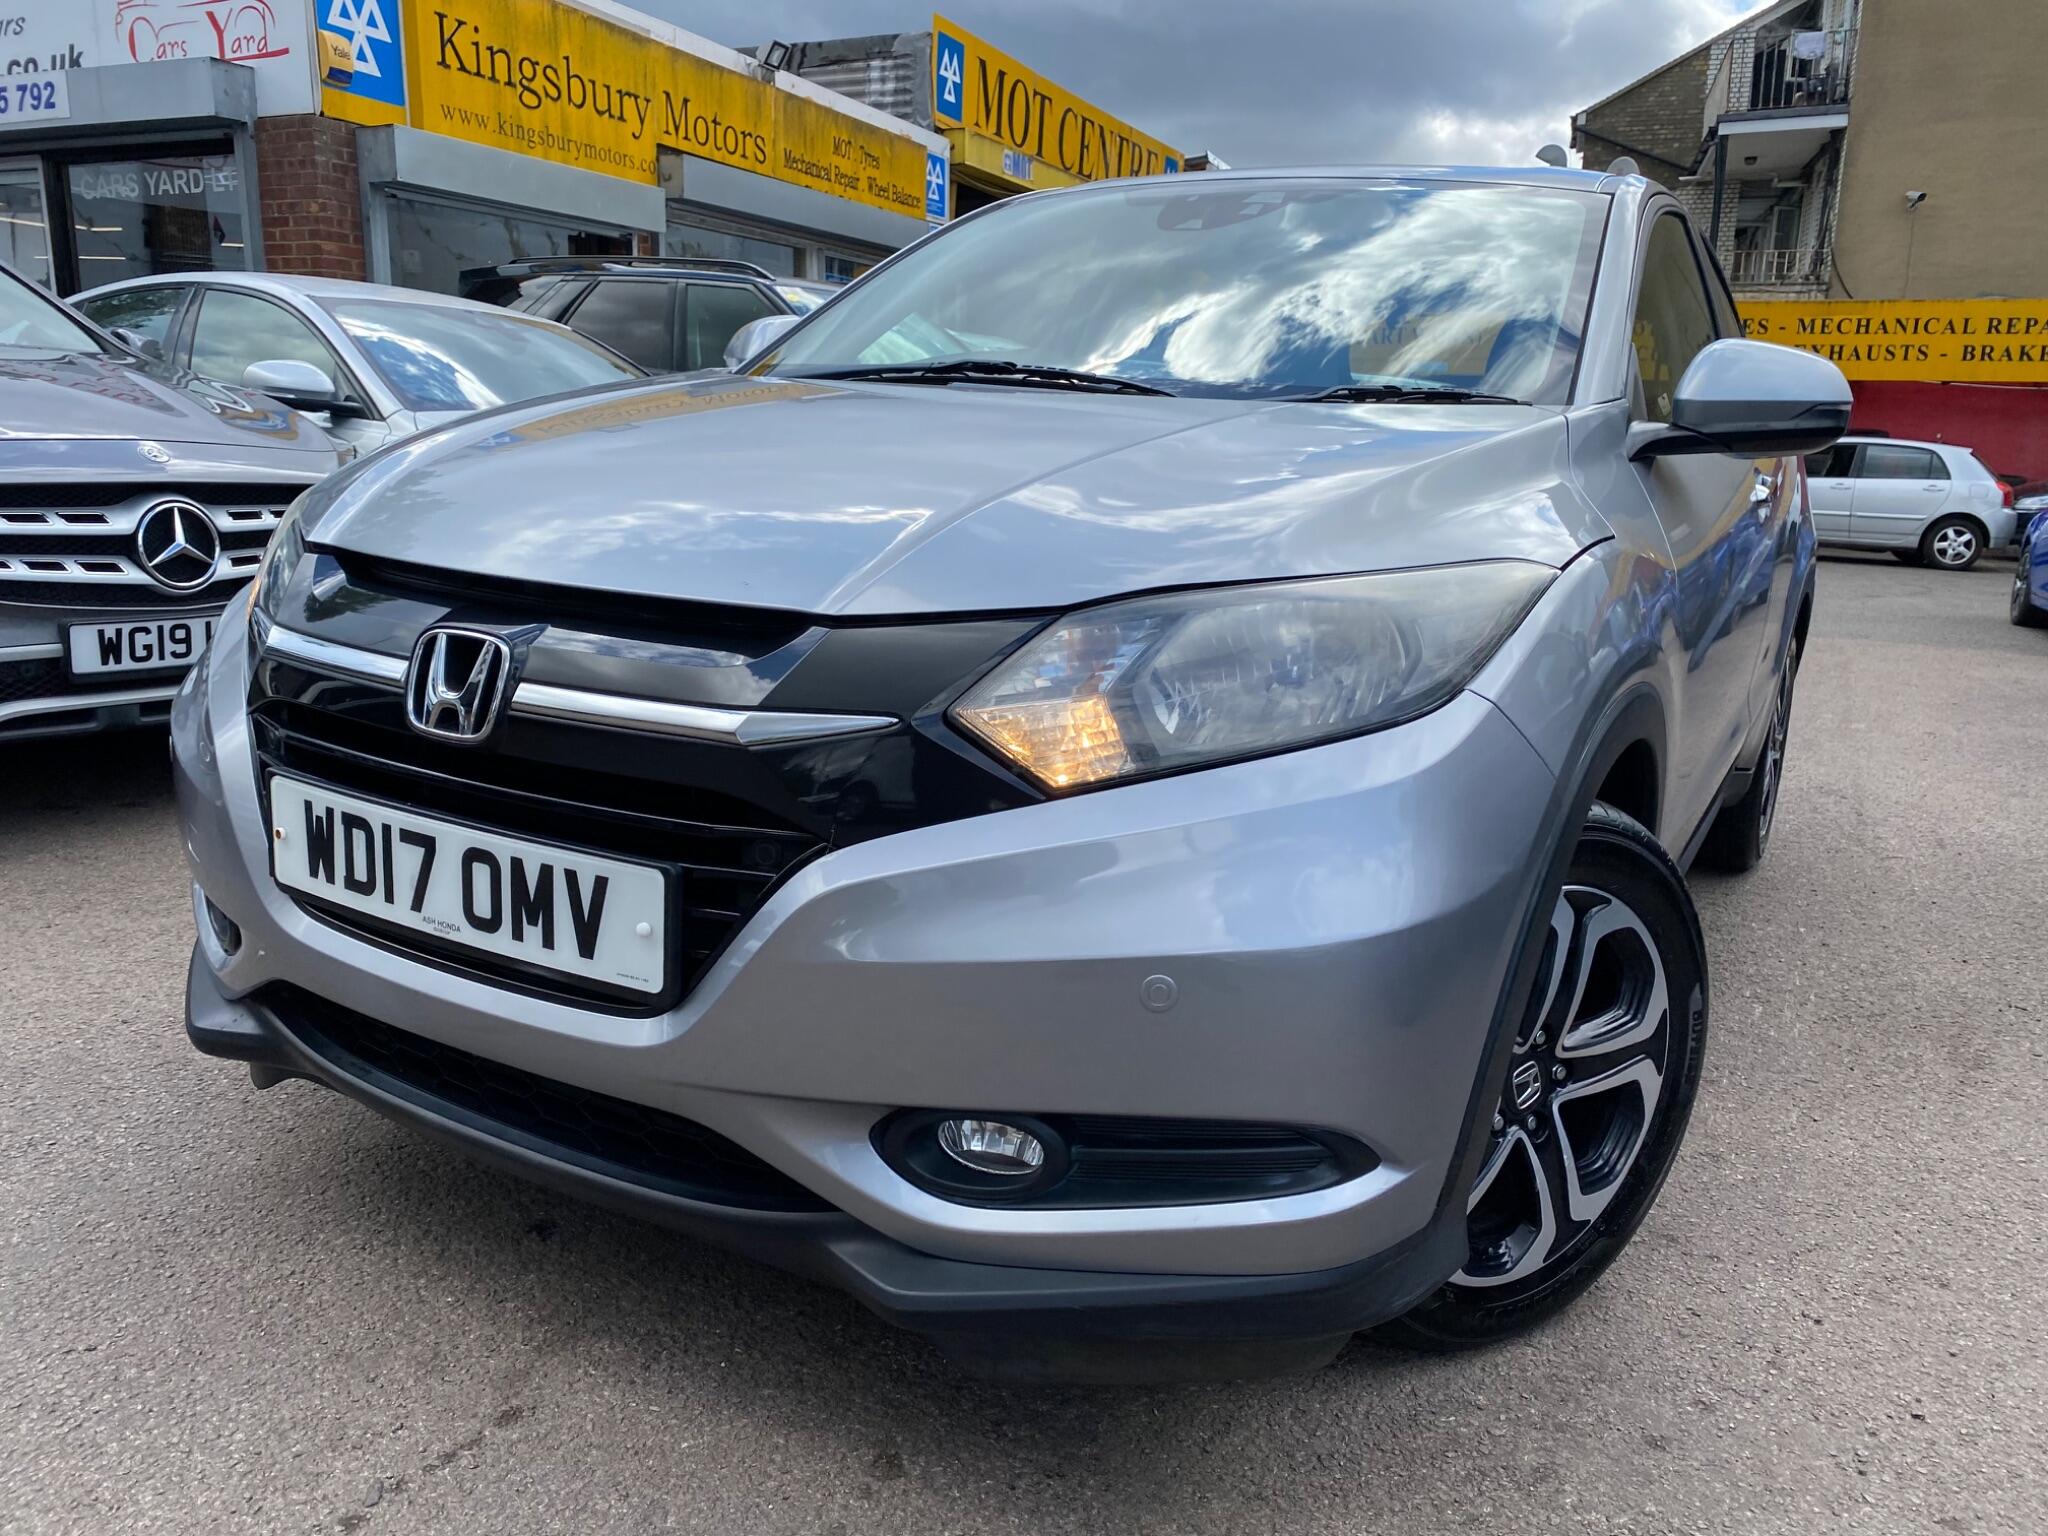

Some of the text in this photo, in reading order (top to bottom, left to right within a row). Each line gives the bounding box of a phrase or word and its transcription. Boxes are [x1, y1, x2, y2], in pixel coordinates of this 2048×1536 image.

[0, 16, 25, 36] rs
[129, 7, 272, 62] Cars Yard
[331, 43, 351, 60] Yale
[16, 81, 56, 112] 792
[434, 11, 767, 165] Kingsbury Motors
[974, 56, 1053, 159] MOT
[832, 136, 881, 170] MOT Tyres
[80, 174, 139, 199] CARS
[144, 168, 204, 196] YARD
[784, 148, 832, 182] Mechanical
[834, 165, 860, 192] Repair
[867, 176, 890, 200] Wheel
[892, 184, 921, 209] Balance
[1796, 317, 1977, 335] MECHANICAL
[97, 622, 192, 666] WG19
[303, 799, 609, 961] WD17 OMV
[422, 915, 436, 925] ASH
[437, 919, 461, 932] HONDA
